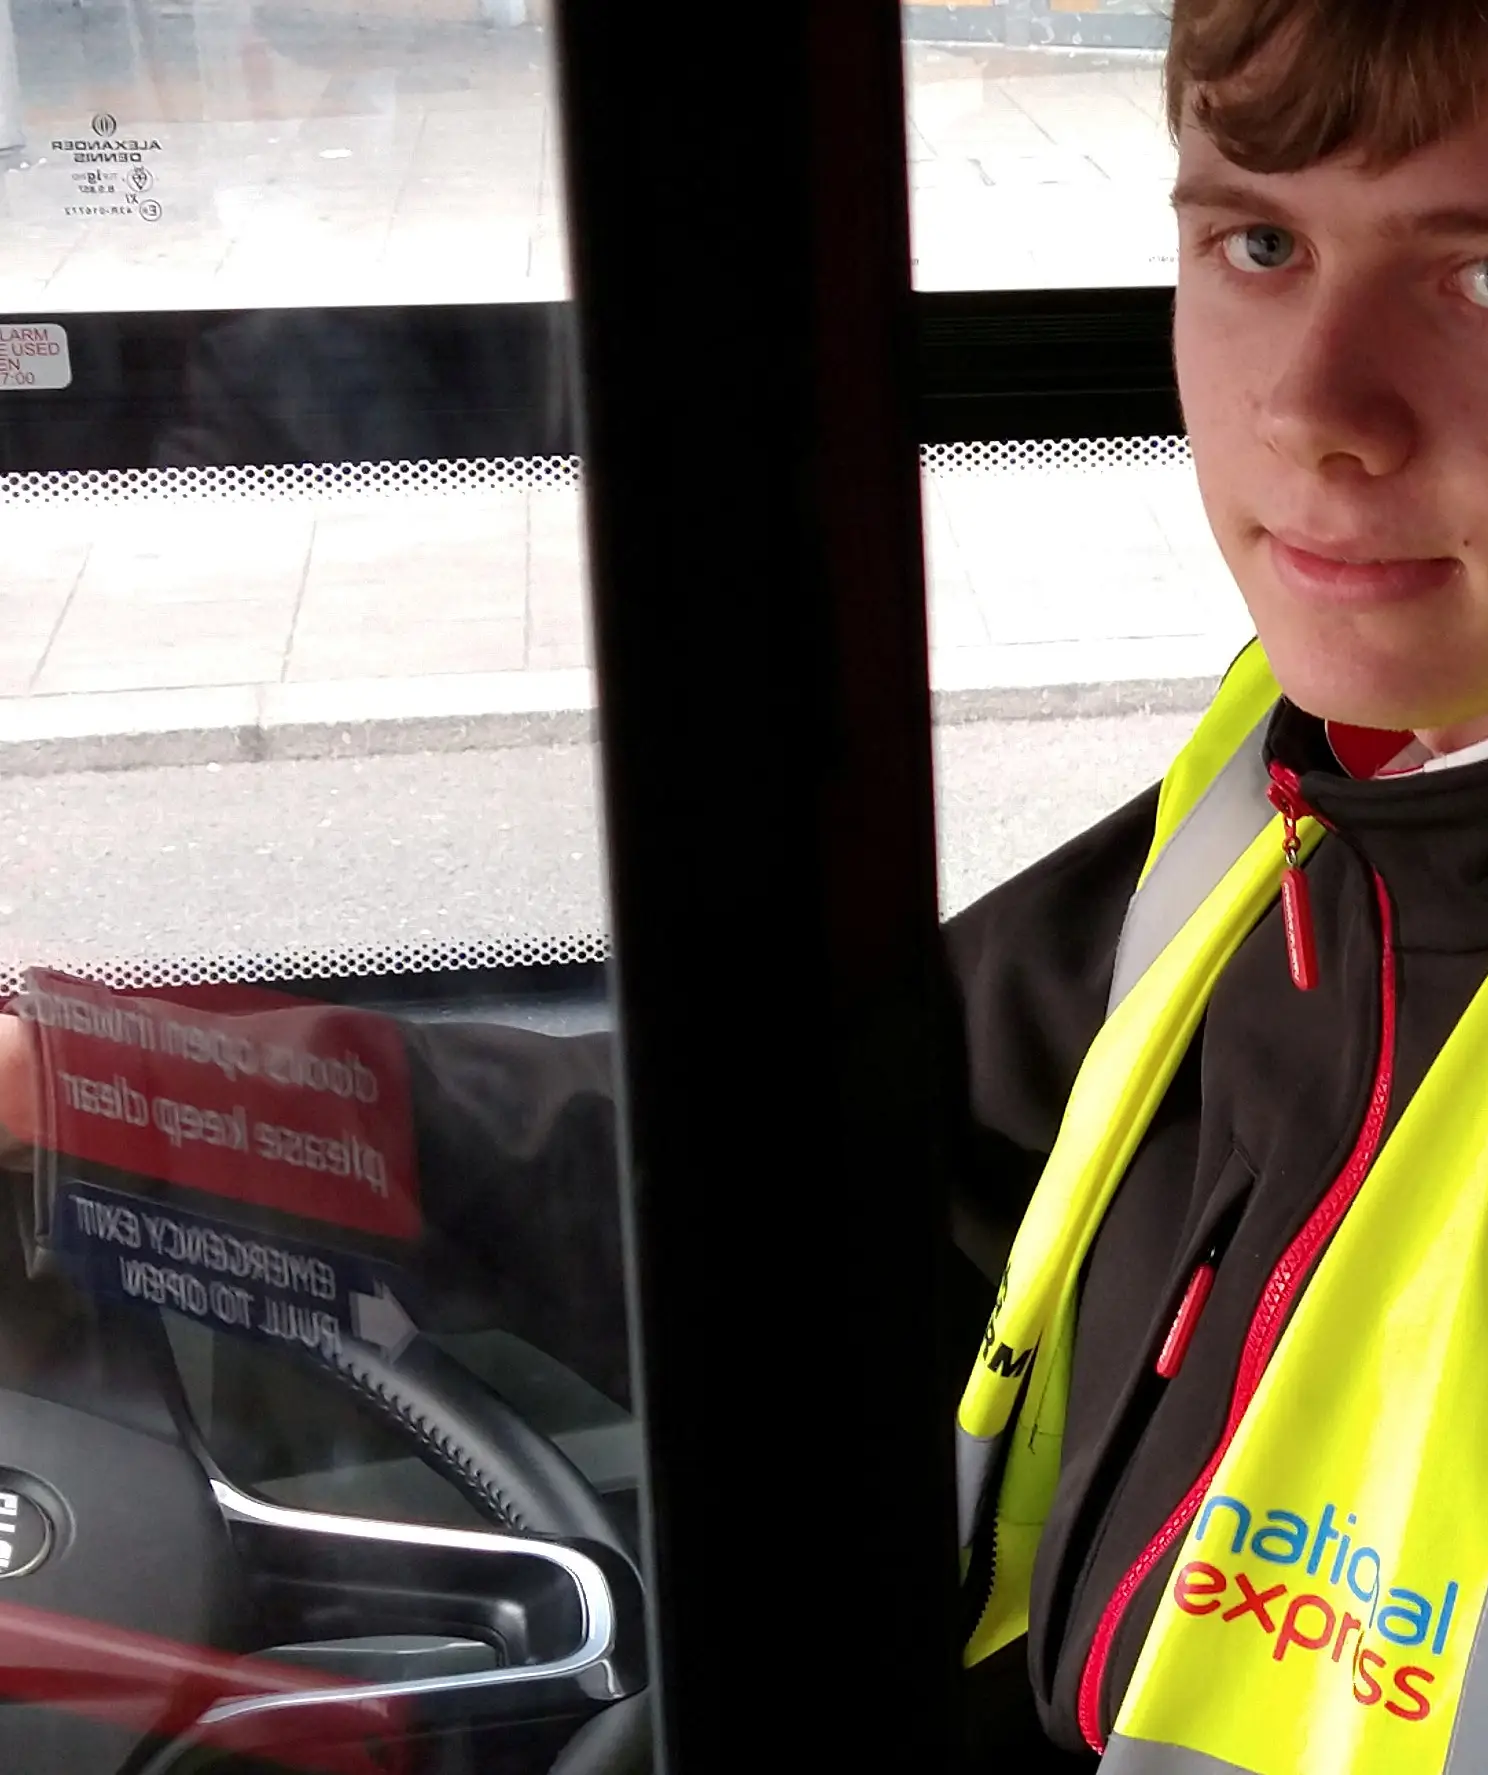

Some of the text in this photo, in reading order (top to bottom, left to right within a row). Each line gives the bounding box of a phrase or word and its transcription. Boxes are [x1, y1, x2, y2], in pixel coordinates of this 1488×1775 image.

[11, 342, 60, 356] USED
[1174, 1561, 1436, 1721] exprss
[1195, 1495, 1459, 1656] natioal
